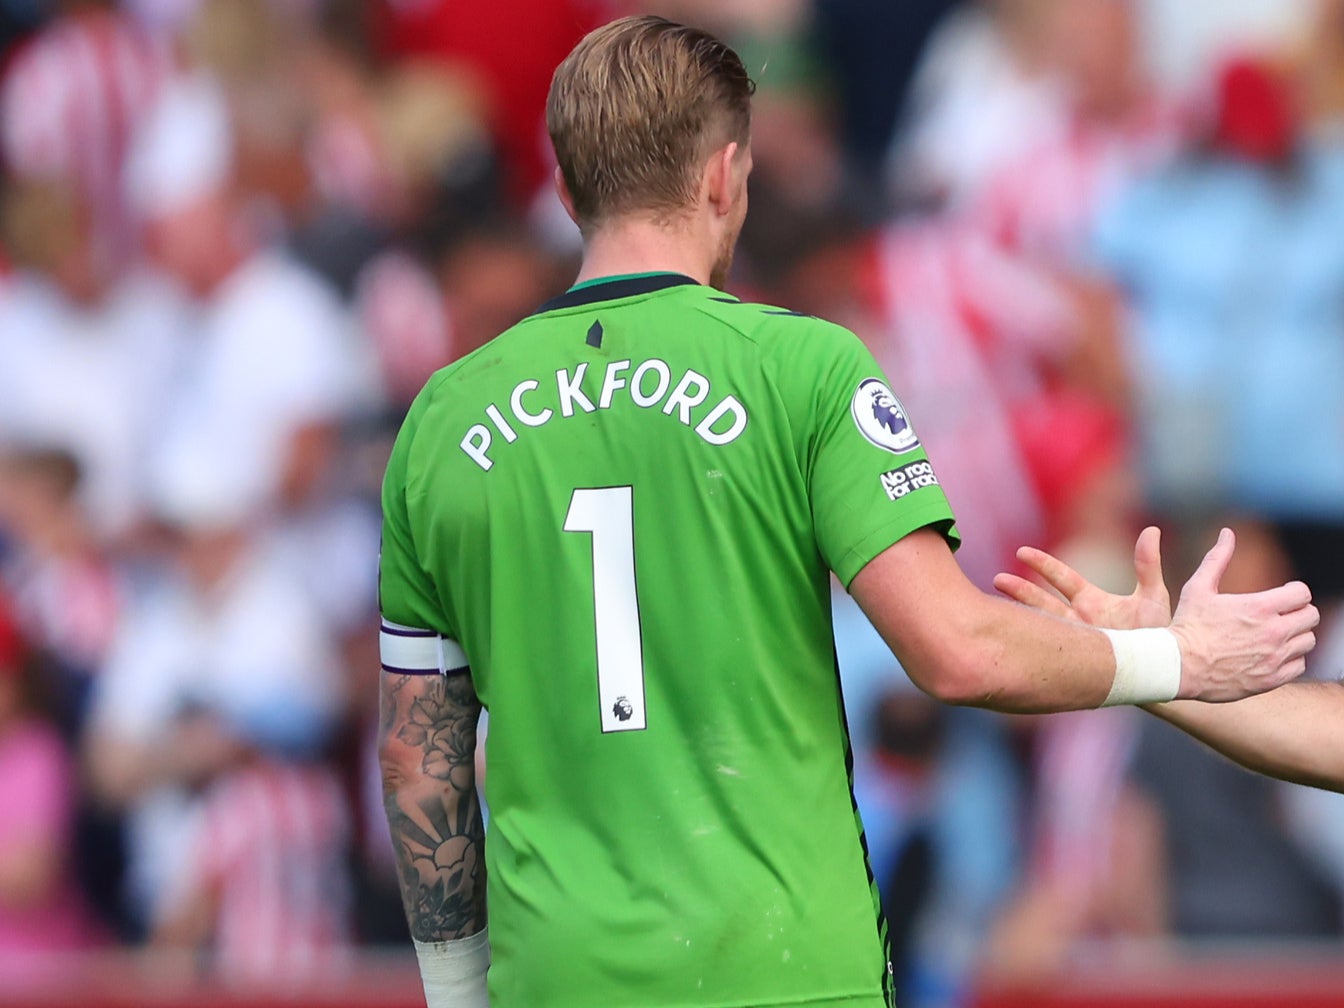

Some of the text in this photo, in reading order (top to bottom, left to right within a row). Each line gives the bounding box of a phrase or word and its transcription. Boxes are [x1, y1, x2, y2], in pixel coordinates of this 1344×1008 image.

[459, 358, 749, 472] PICKFORD
[880, 470, 906, 488] No
[886, 481, 911, 501] for
[562, 484, 648, 734] 1
